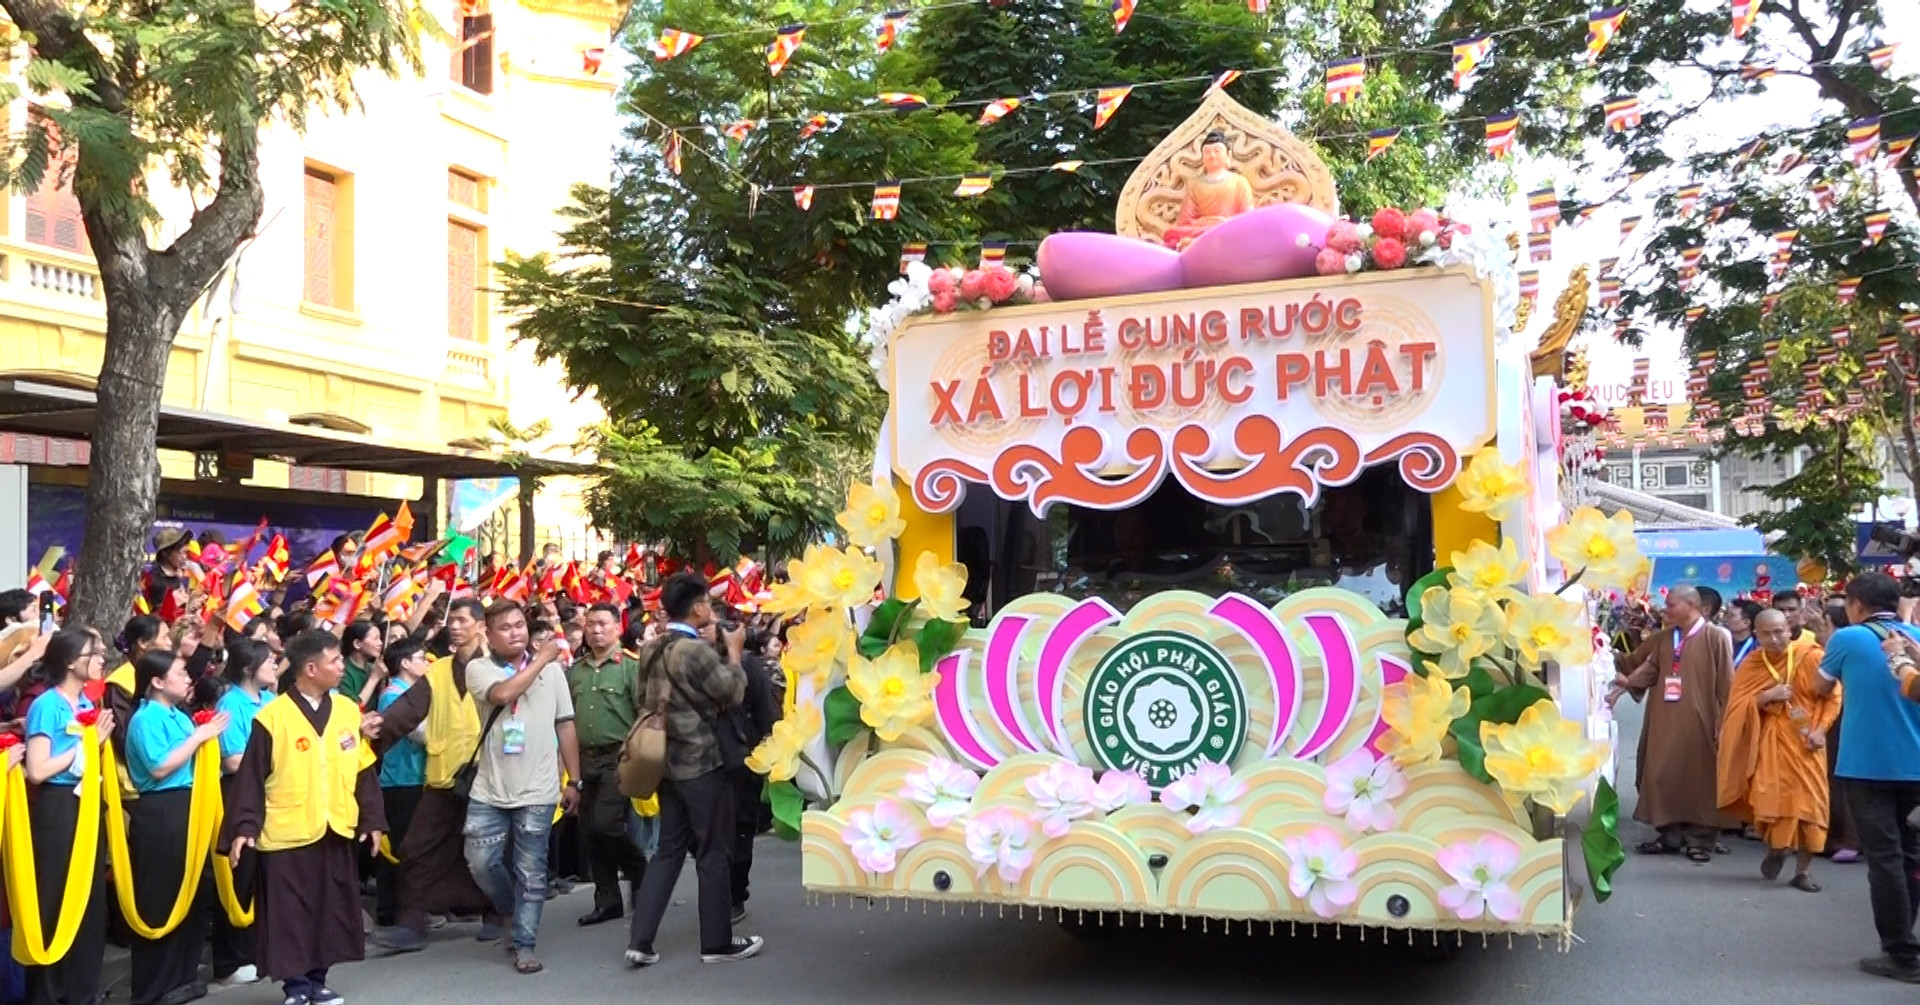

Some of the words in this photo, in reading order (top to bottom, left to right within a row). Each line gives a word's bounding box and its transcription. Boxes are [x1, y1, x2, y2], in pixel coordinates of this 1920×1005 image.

[987, 328, 1050, 366] ĐẠI
[1061, 309, 1106, 355] LỄ
[1118, 310, 1228, 350] CUNG
[1240, 292, 1363, 340] RƯỚC
[930, 366, 1004, 425] XÁ
[1019, 366, 1117, 427] LỢI
[1128, 347, 1255, 410] ĐỨC
[1275, 338, 1436, 405] PHẬT
[1098, 680, 1119, 728] GIÁO
[1116, 650, 1150, 679] HỘI
[1157, 648, 1209, 676] PHẬT
[1206, 679, 1232, 728] GIÁO
[1121, 751, 1162, 780] VIỆT
[1168, 752, 1210, 780] NAM
